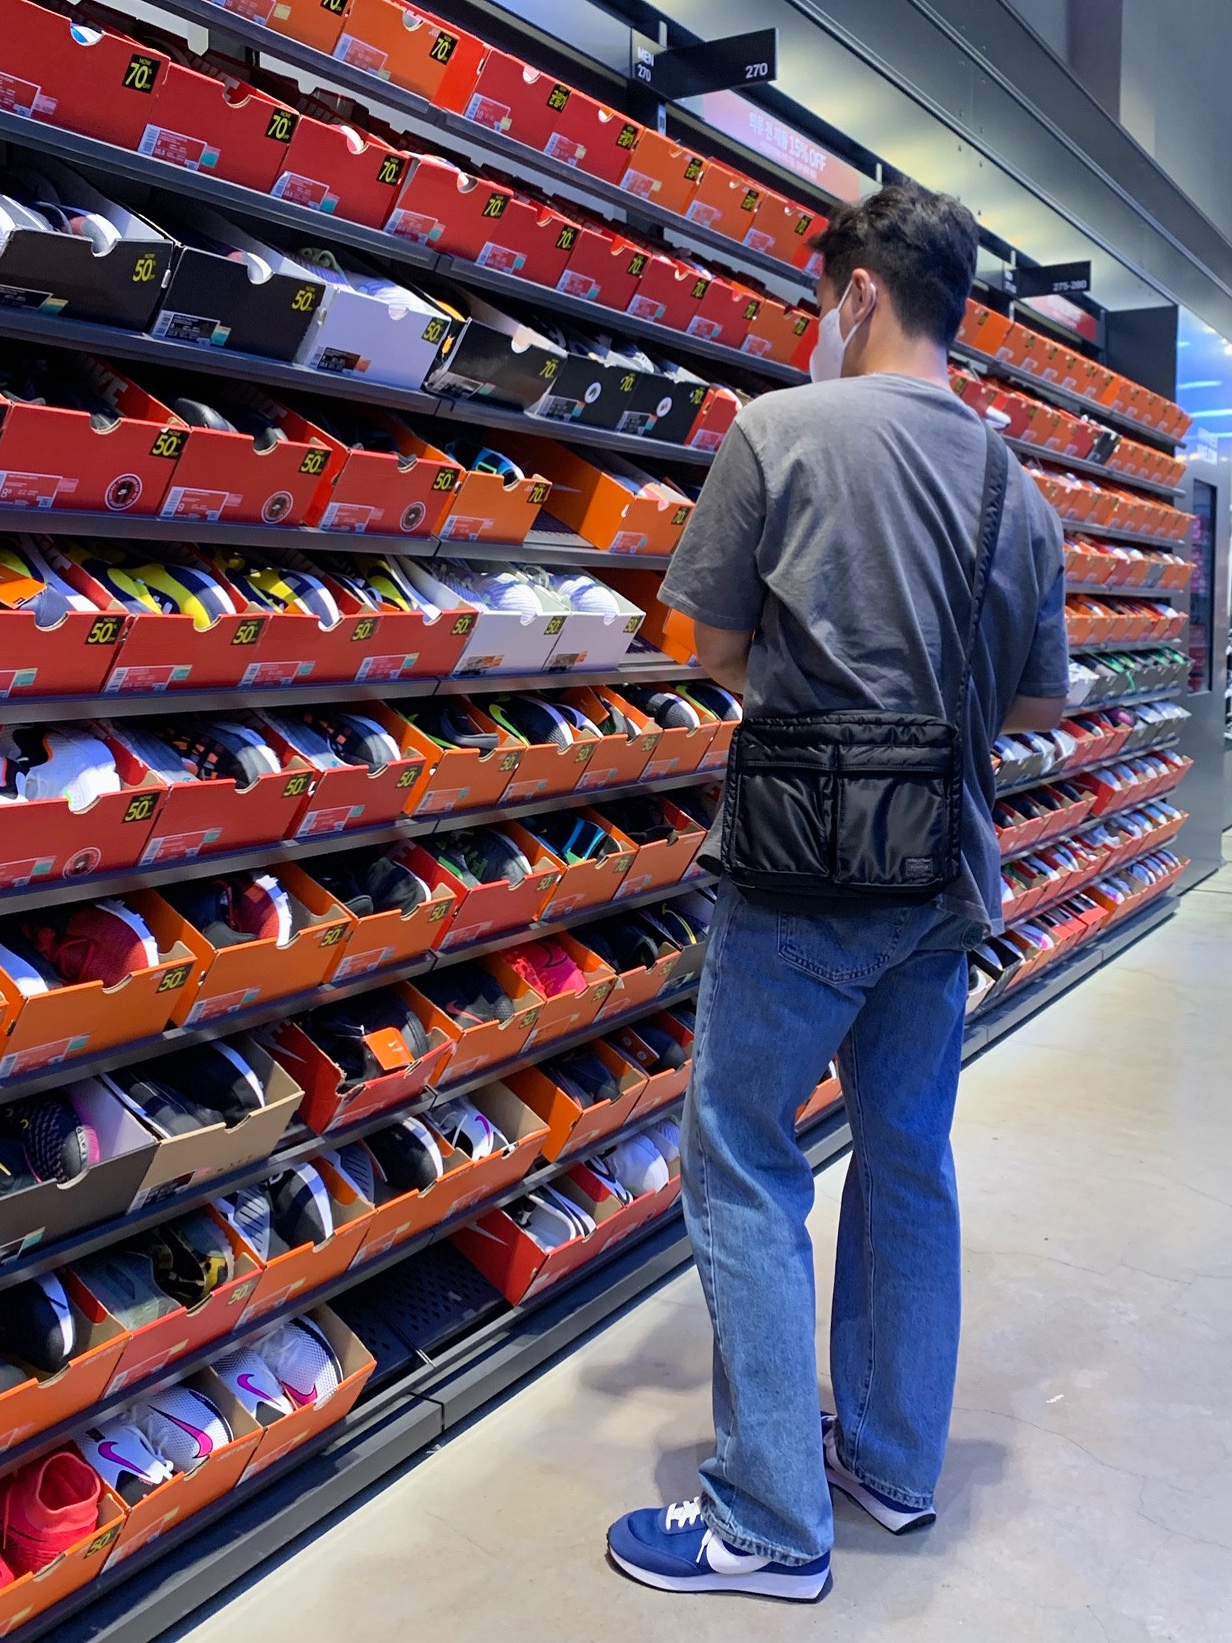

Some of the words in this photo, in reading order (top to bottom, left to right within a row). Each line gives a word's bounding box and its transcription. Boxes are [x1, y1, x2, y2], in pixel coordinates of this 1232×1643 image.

[139, 57, 153, 66] NOW
[637, 47, 655, 67] MEN
[637, 64, 651, 82] 270
[745, 62, 768, 78] 270
[280, 110, 291, 118] NOW
